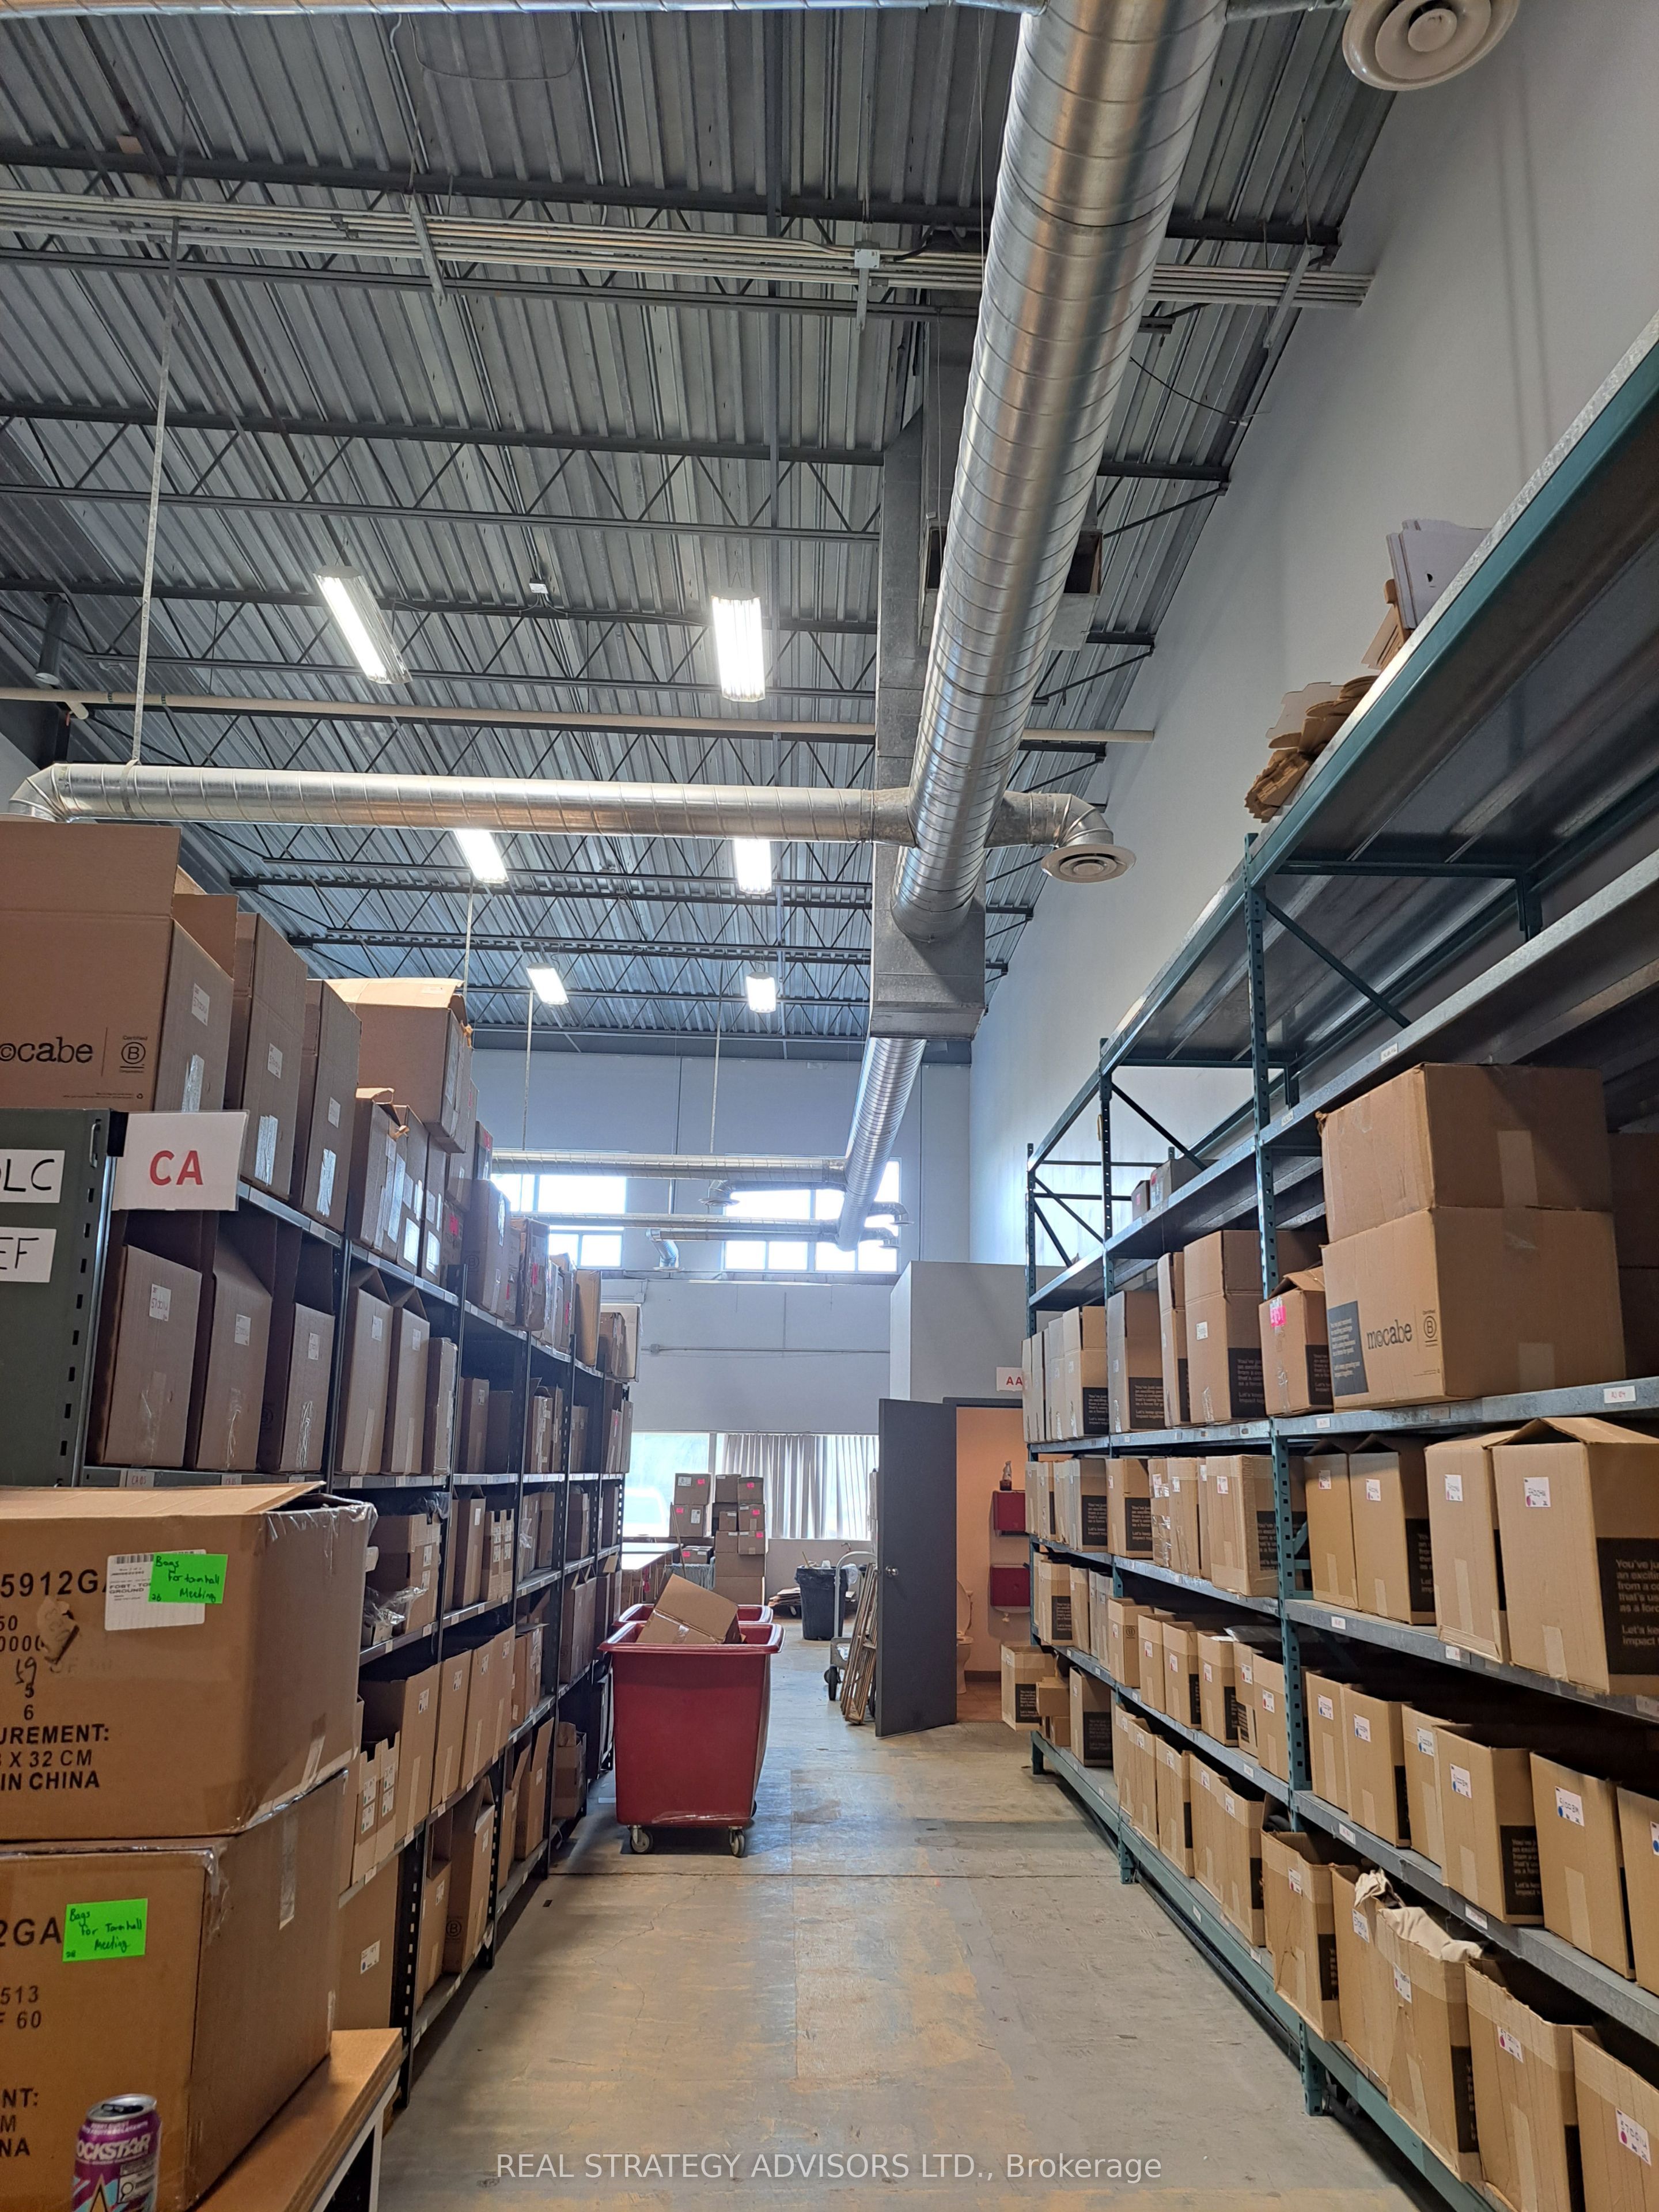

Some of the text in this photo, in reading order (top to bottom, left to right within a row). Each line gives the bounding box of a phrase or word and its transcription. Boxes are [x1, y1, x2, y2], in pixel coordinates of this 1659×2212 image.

[0, 1158, 55, 1192] LC
[149, 1150, 204, 1187] CA
[156, 1555, 179, 1573] Bags
[0, 1569, 106, 1597] 5912G
[24, 1705, 35, 1721] 6
[9, 1749, 93, 1768] X 32 CM
[29, 1770, 100, 1790] CHINA
[69, 1908, 90, 1926] Bags
[17, 2010, 41, 2029] 60
